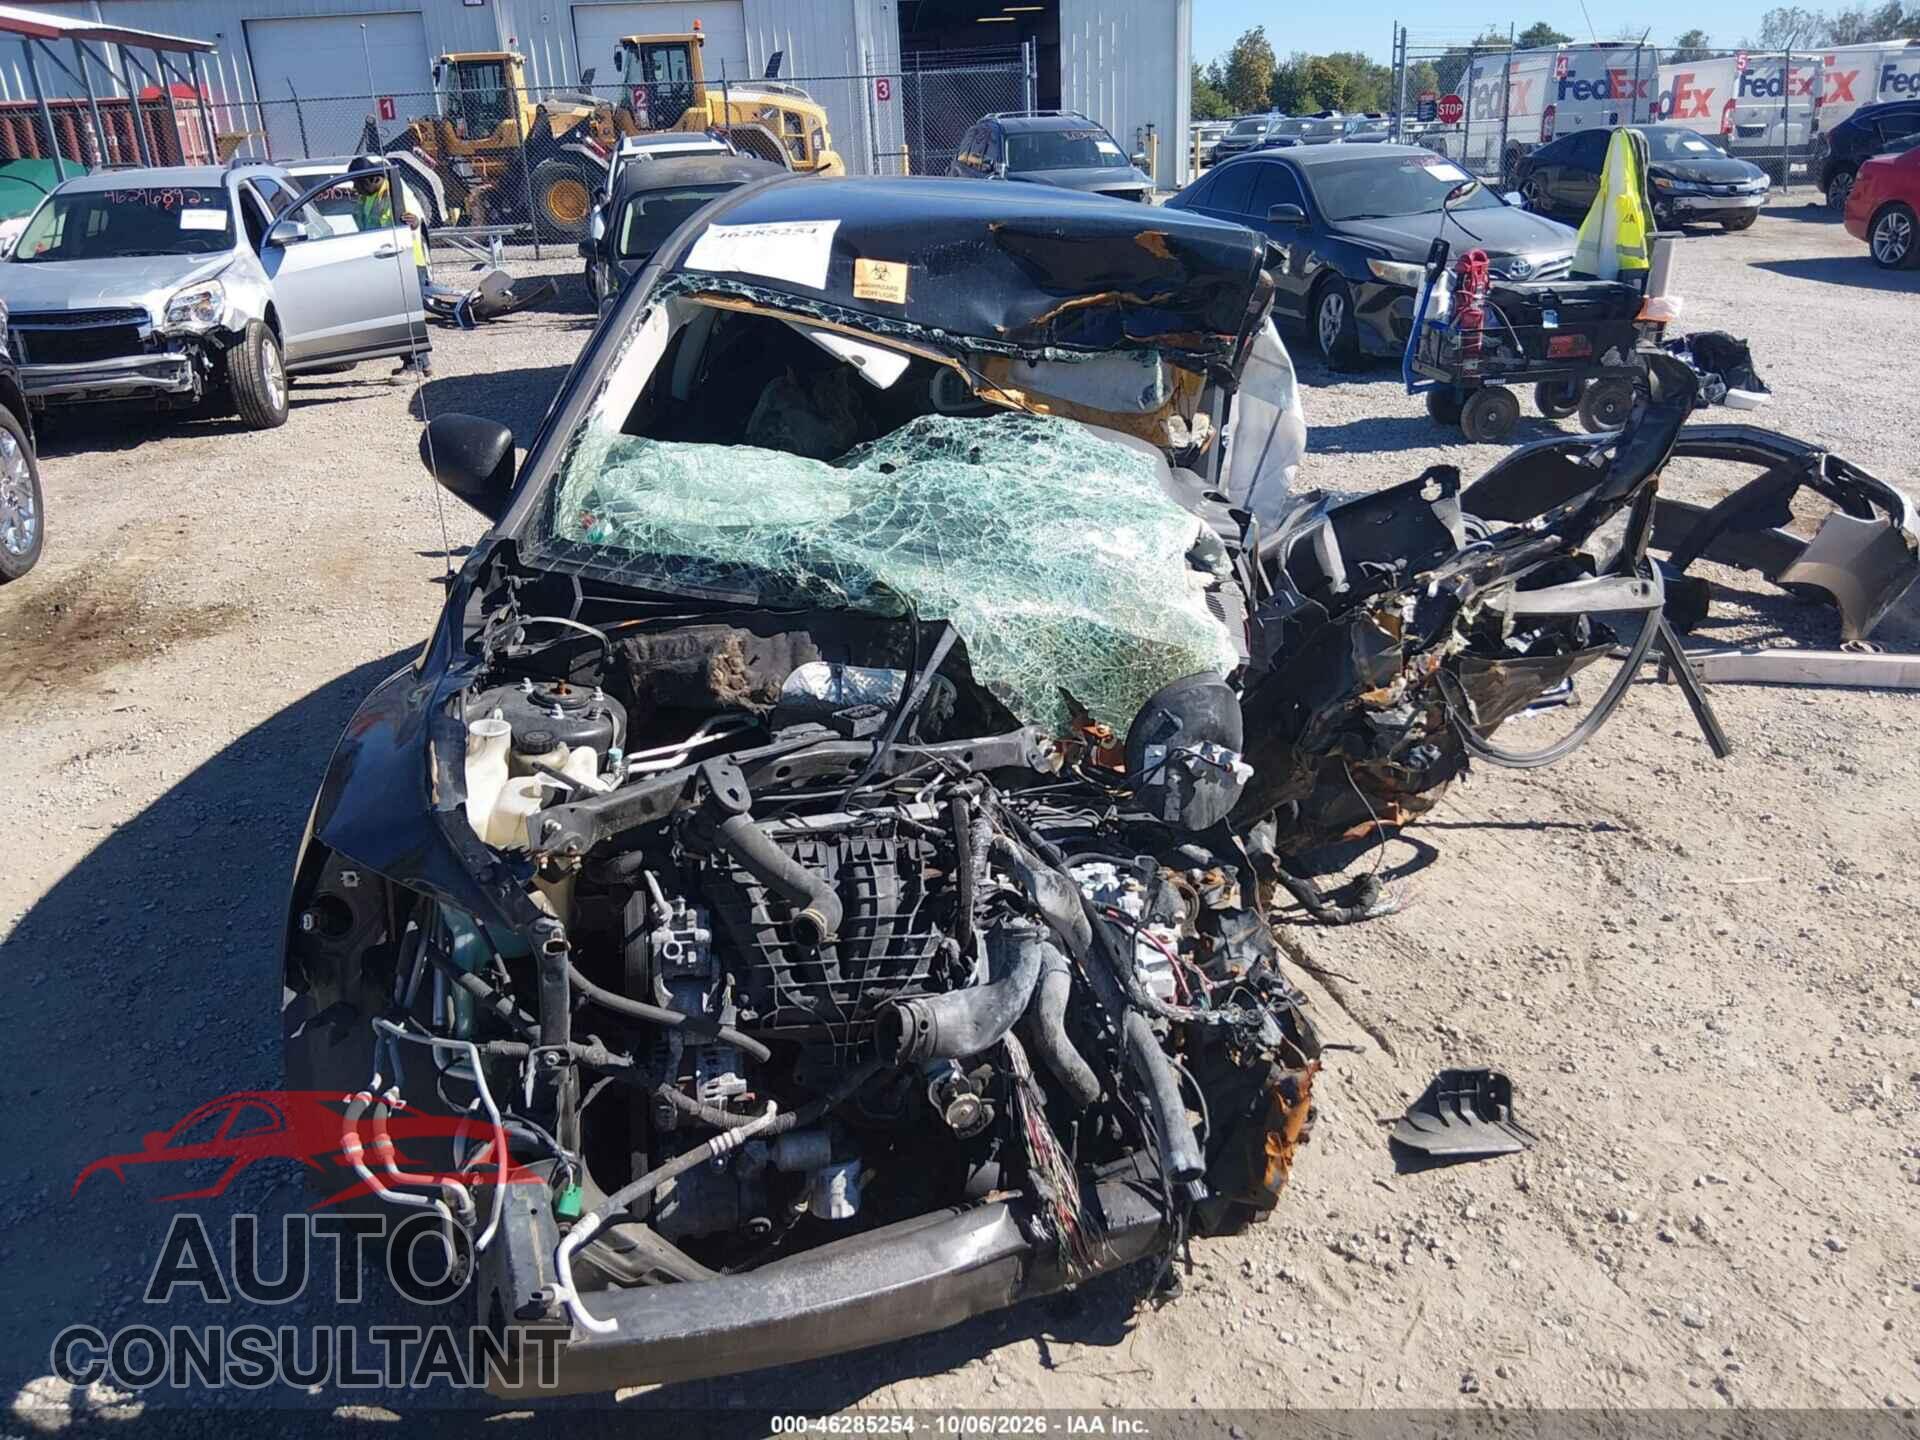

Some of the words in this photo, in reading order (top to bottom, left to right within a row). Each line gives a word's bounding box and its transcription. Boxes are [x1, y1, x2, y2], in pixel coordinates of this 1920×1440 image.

[1736, 54, 1748, 70] 5
[878, 81, 889, 99] 3
[1557, 68, 1649, 101] FedEx
[1738, 66, 1815, 98] FedEx
[635, 90, 646, 108] 2
[1658, 72, 1715, 121] dEx
[383, 100, 393, 118] 1
[1438, 103, 1464, 116] STOP
